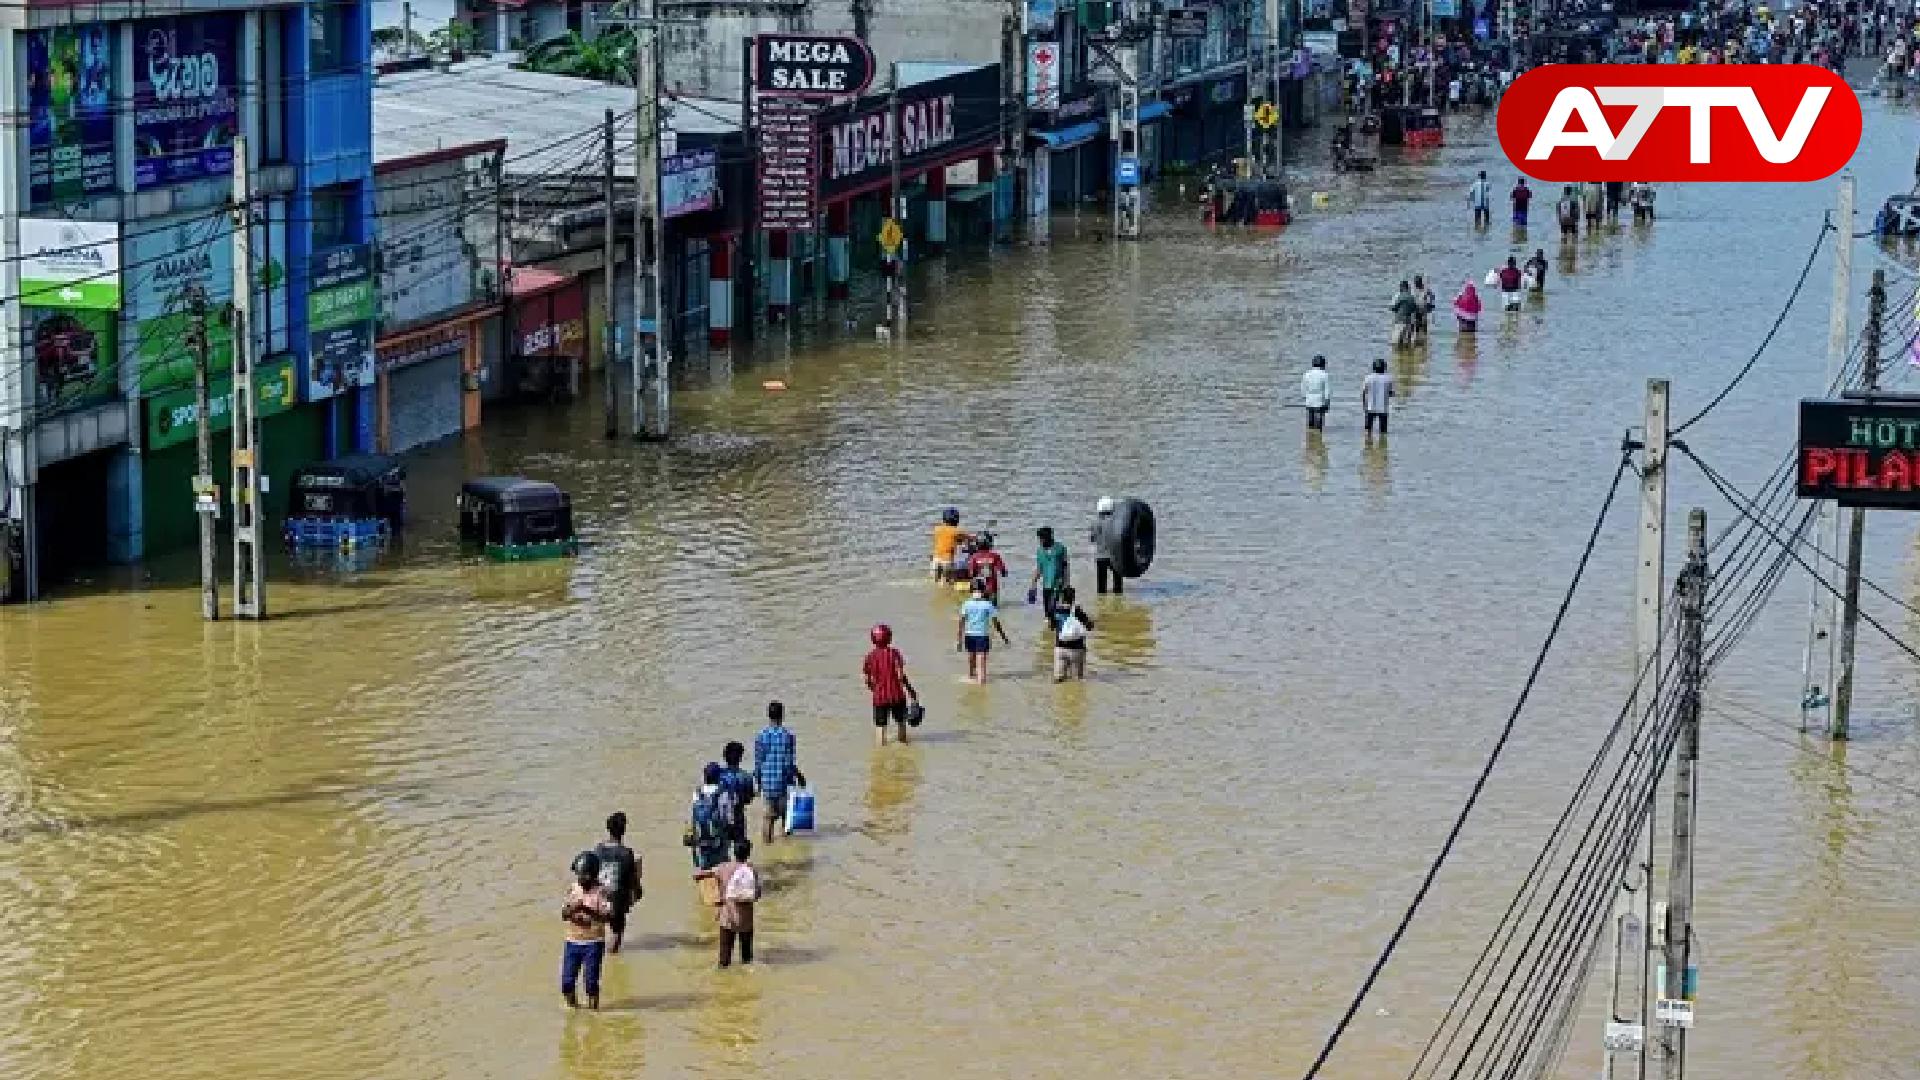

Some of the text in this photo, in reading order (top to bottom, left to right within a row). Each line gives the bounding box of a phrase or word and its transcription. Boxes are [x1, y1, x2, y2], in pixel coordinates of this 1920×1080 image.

[769, 41, 851, 64] MEGA
[771, 68, 847, 90] SALE
[832, 111, 893, 179] MEGA
[902, 94, 955, 156] SALE
